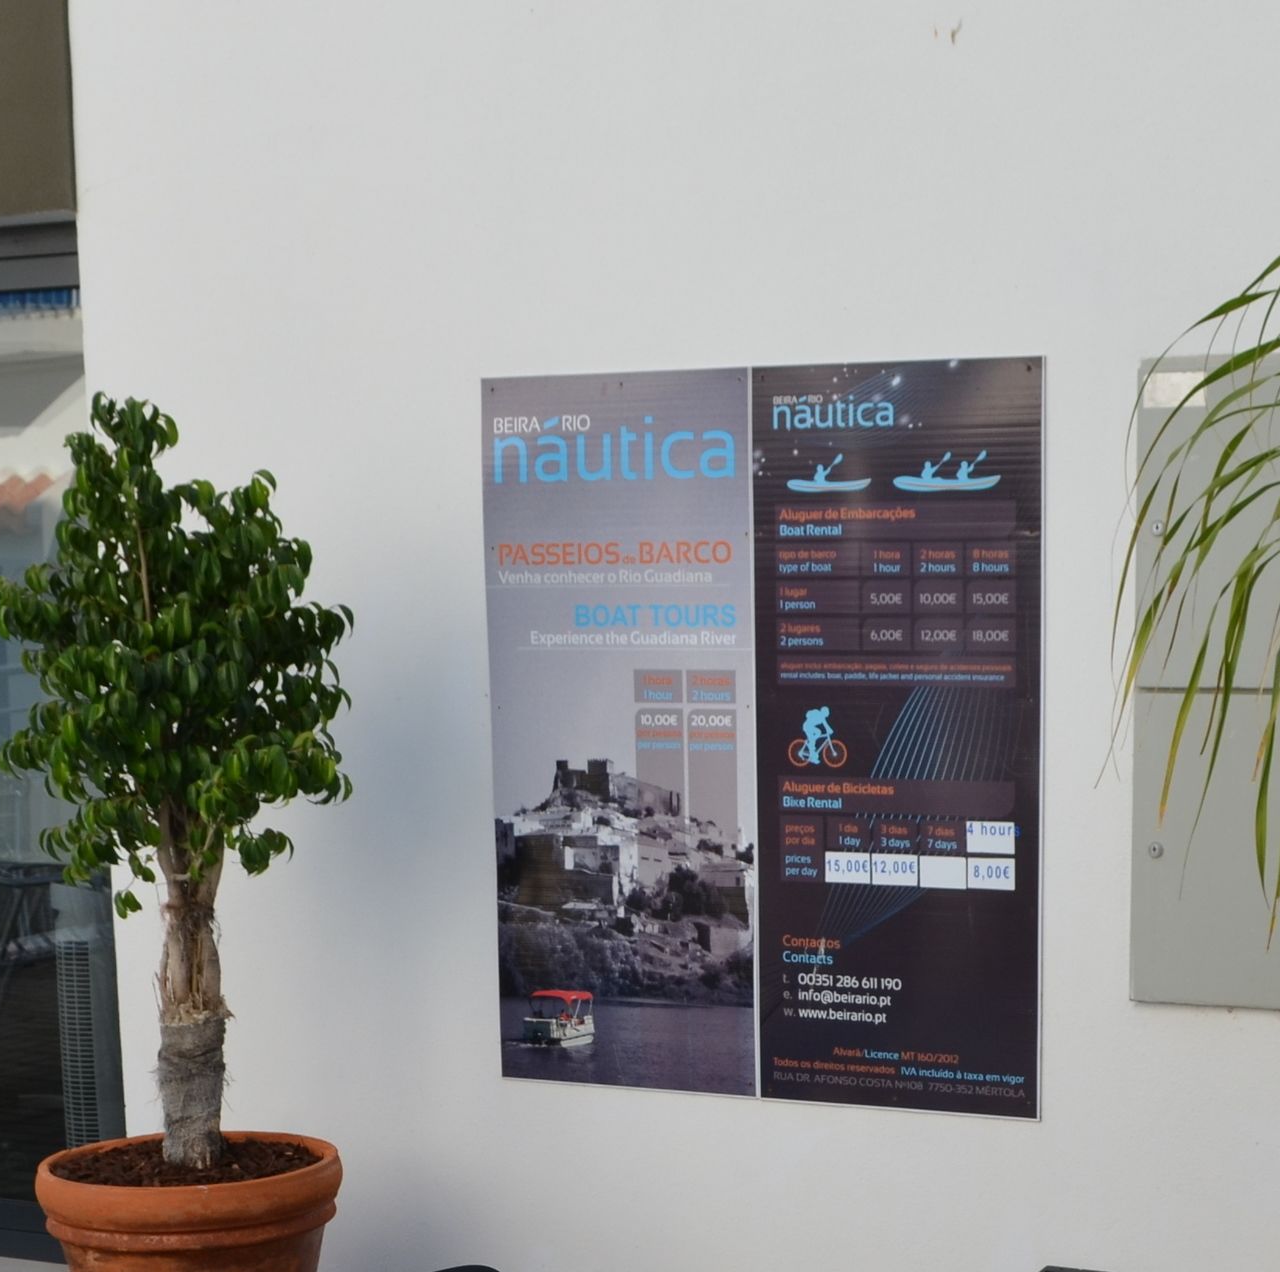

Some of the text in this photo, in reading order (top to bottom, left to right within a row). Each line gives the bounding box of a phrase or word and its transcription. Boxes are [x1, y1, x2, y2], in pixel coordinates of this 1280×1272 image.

[493, 414, 591, 434] BEIRA RIO
[779, 507, 916, 523] Aluguer de Embarcações
[779, 524, 842, 537] Boat Rental
[498, 542, 621, 567] PASSEIOS
[638, 540, 733, 565] BARCO
[880, 550, 900, 559] hora
[920, 550, 956, 559] 2 horas
[981, 549, 1009, 559] horas
[779, 562, 832, 573] type of boat
[880, 563, 901, 572] hour
[920, 563, 956, 572] 2 hours
[973, 562, 1009, 572] 8 hours
[498, 569, 713, 584] Venha conhecer o Rio Guadiana
[784, 587, 808, 598] lugar
[785, 600, 816, 611] person
[870, 593, 902, 606] 5,00€
[920, 593, 957, 606] 10,00€
[973, 593, 1009, 606] 15,00€
[574, 603, 737, 628] BOAT TOURS
[780, 623, 821, 634] 2 lugares
[530, 630, 737, 647] Experience the Guadiana River
[780, 635, 824, 647] 2 persons
[870, 629, 903, 642] 6,00€
[921, 629, 957, 642] 12,00€
[973, 629, 1009, 642] 18,00€
[914, 673, 943, 681] personal
[640, 714, 678, 727] 10,00€
[691, 714, 733, 728] 20,00€
[783, 781, 895, 795] Aluguer de Bicicletas
[783, 796, 842, 809] Bike Rental
[785, 824, 815, 834] preços
[889, 824, 908, 834] dias
[935, 826, 955, 837] dias
[967, 822, 1022, 838] 4 hours
[785, 836, 815, 846] por dia
[844, 836, 861, 847] day
[881, 837, 910, 848] 3 days
[928, 839, 957, 850] 7 days
[785, 855, 811, 864] prices
[785, 867, 818, 878] per day
[827, 860, 869, 875] 15,00€
[873, 860, 916, 875] 12,00€
[973, 864, 1010, 880] 8,00€
[782, 934, 841, 949] Contactos
[782, 951, 834, 965] Contacts
[798, 973, 833, 986] 00351
[836, 975, 859, 988] 286
[861, 976, 878, 989] 611
[880, 978, 902, 991] 190
[783, 988, 892, 1008] e. info@beirario.pt
[783, 1008, 887, 1025] w. www.beirario.pt
[901, 1051, 917, 1060] MT
[773, 1057, 798, 1068] Todos
[813, 1060, 845, 1071] direitos
[847, 1063, 896, 1074] reservados
[901, 1066, 917, 1076] IVA
[919, 1067, 954, 1079] incluído
[964, 1071, 984, 1081] taxa
[985, 1073, 1000, 1081] em
[1002, 1074, 1024, 1085] vigor
[773, 1071, 793, 1081] RUA
[814, 1074, 857, 1086] AFONSO
[859, 1077, 893, 1089] COSTA
